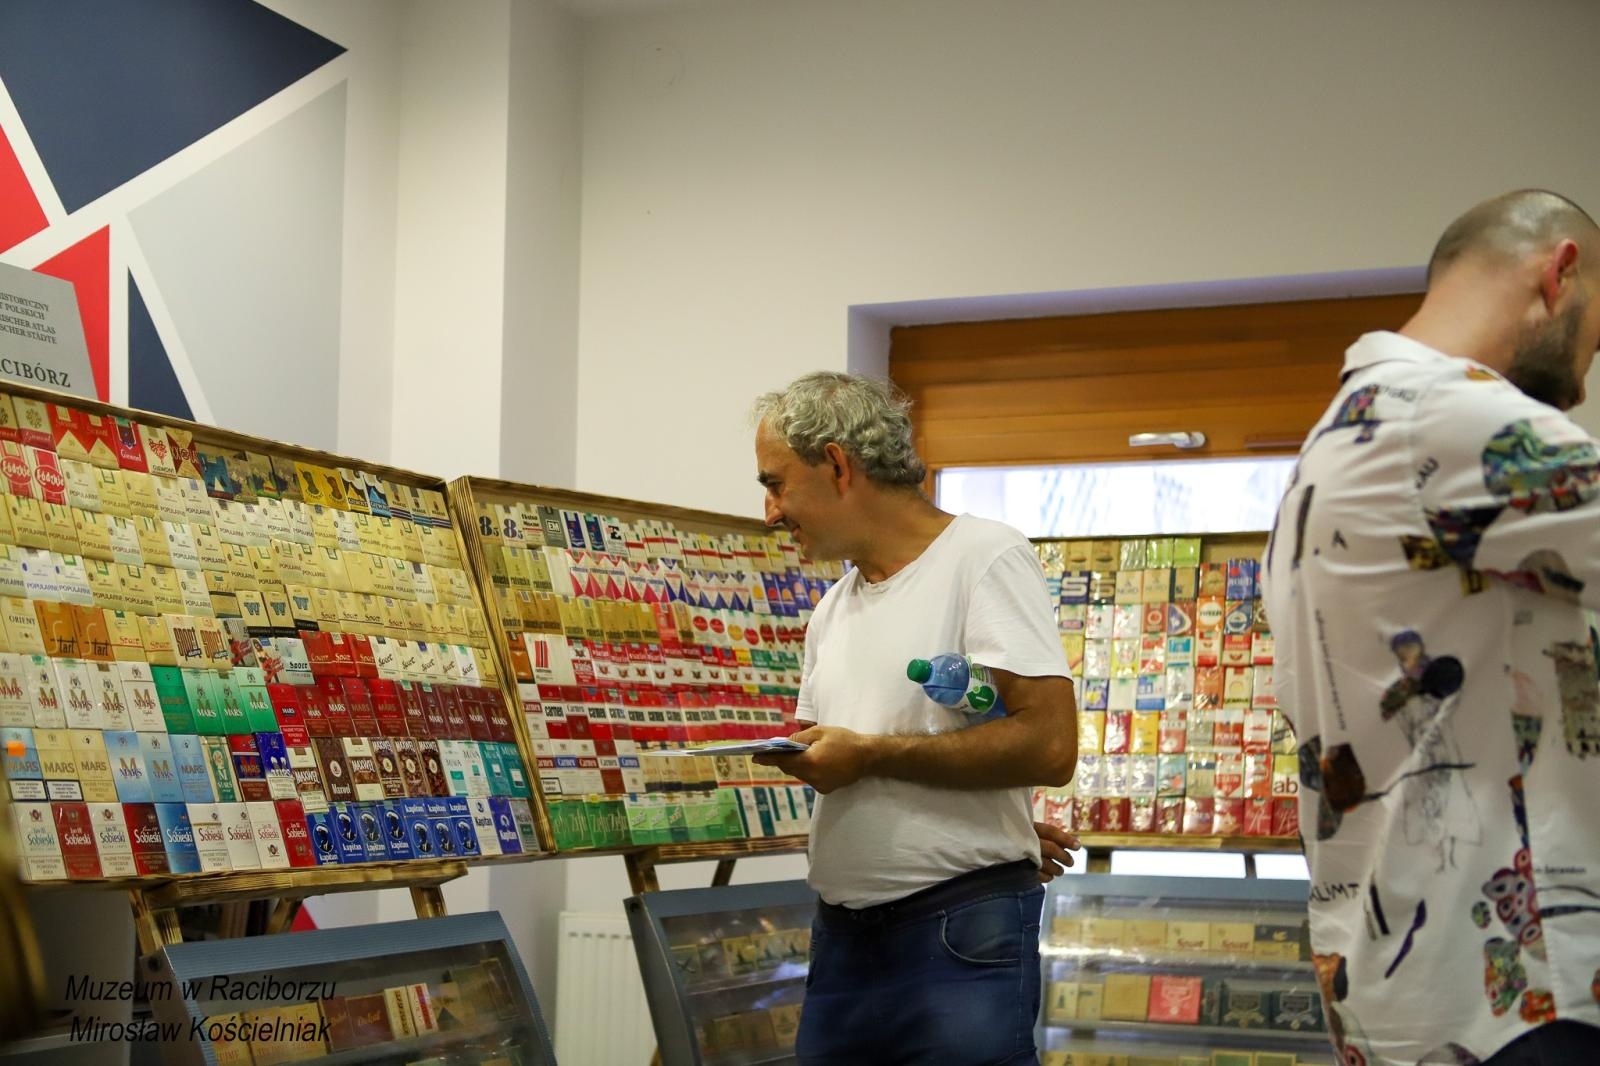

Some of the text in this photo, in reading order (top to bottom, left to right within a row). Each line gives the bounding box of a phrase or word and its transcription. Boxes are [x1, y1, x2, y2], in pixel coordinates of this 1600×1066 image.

[32, 322, 56, 334] ATLAS
[0, 358, 71, 388] CIBÓRZ
[1273, 777, 1299, 795] ab
[27, 834, 55, 846] Sobieski
[65, 834, 92, 846] Sobieski
[100, 833, 126, 844] Sobieski
[134, 829, 162, 844] Sobieski
[167, 829, 193, 843] Sobieski
[199, 828, 224, 842] Sobieski
[228, 826, 252, 841] Sobieski
[287, 827, 308, 839] Sobieski
